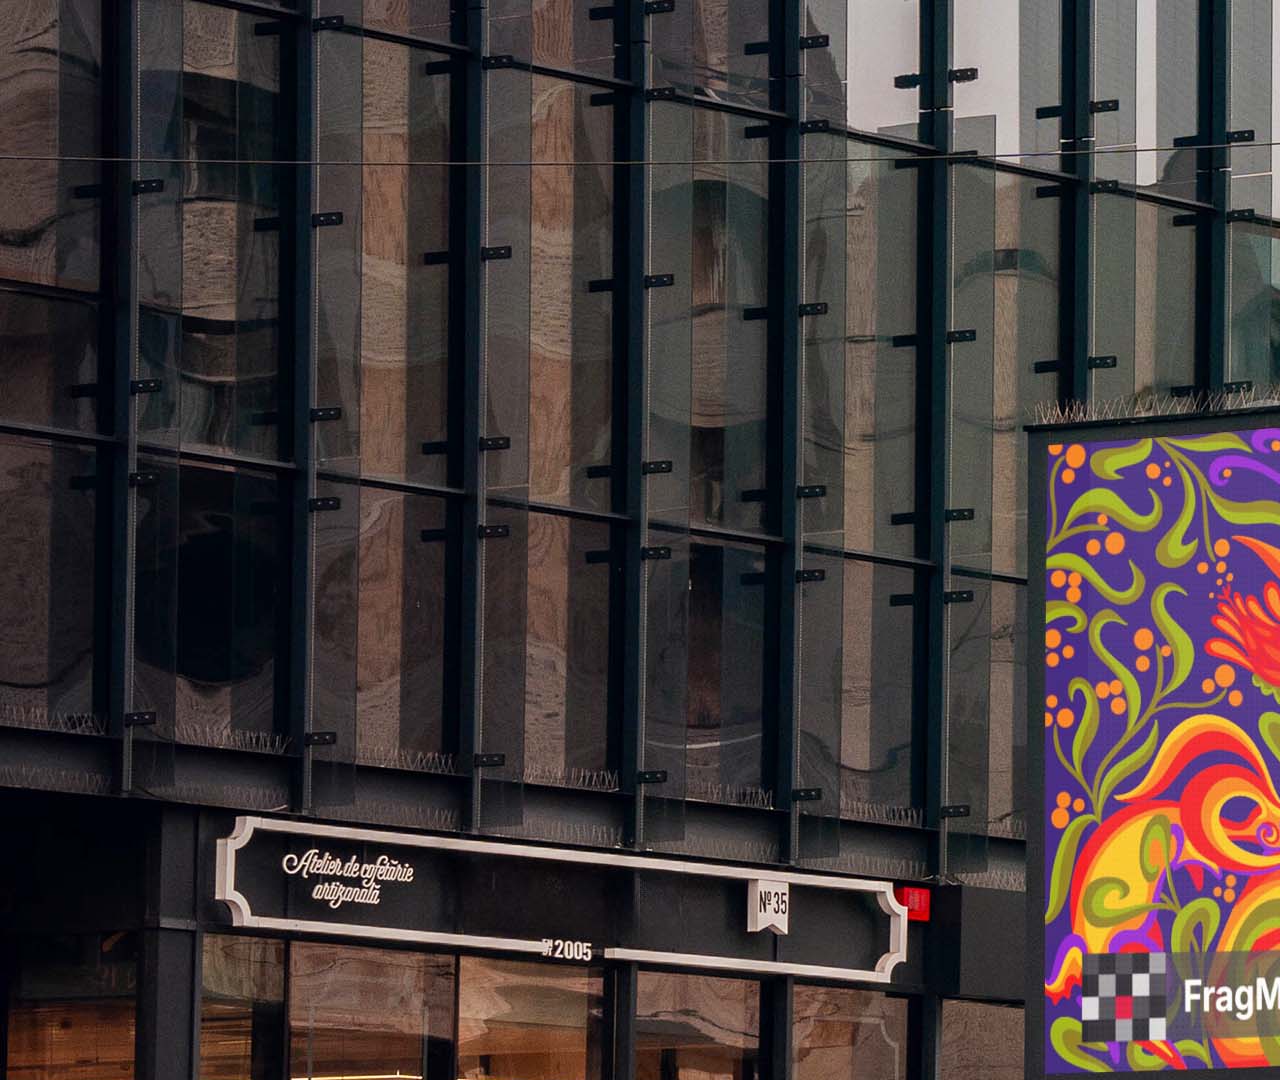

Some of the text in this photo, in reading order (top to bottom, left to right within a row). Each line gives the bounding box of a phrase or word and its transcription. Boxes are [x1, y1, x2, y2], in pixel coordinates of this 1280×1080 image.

[282, 849, 414, 888] Atelier de cofetărie
[312, 881, 381, 909] artizanală
[774, 891, 788, 915] 35
[553, 939, 592, 961] 2005
